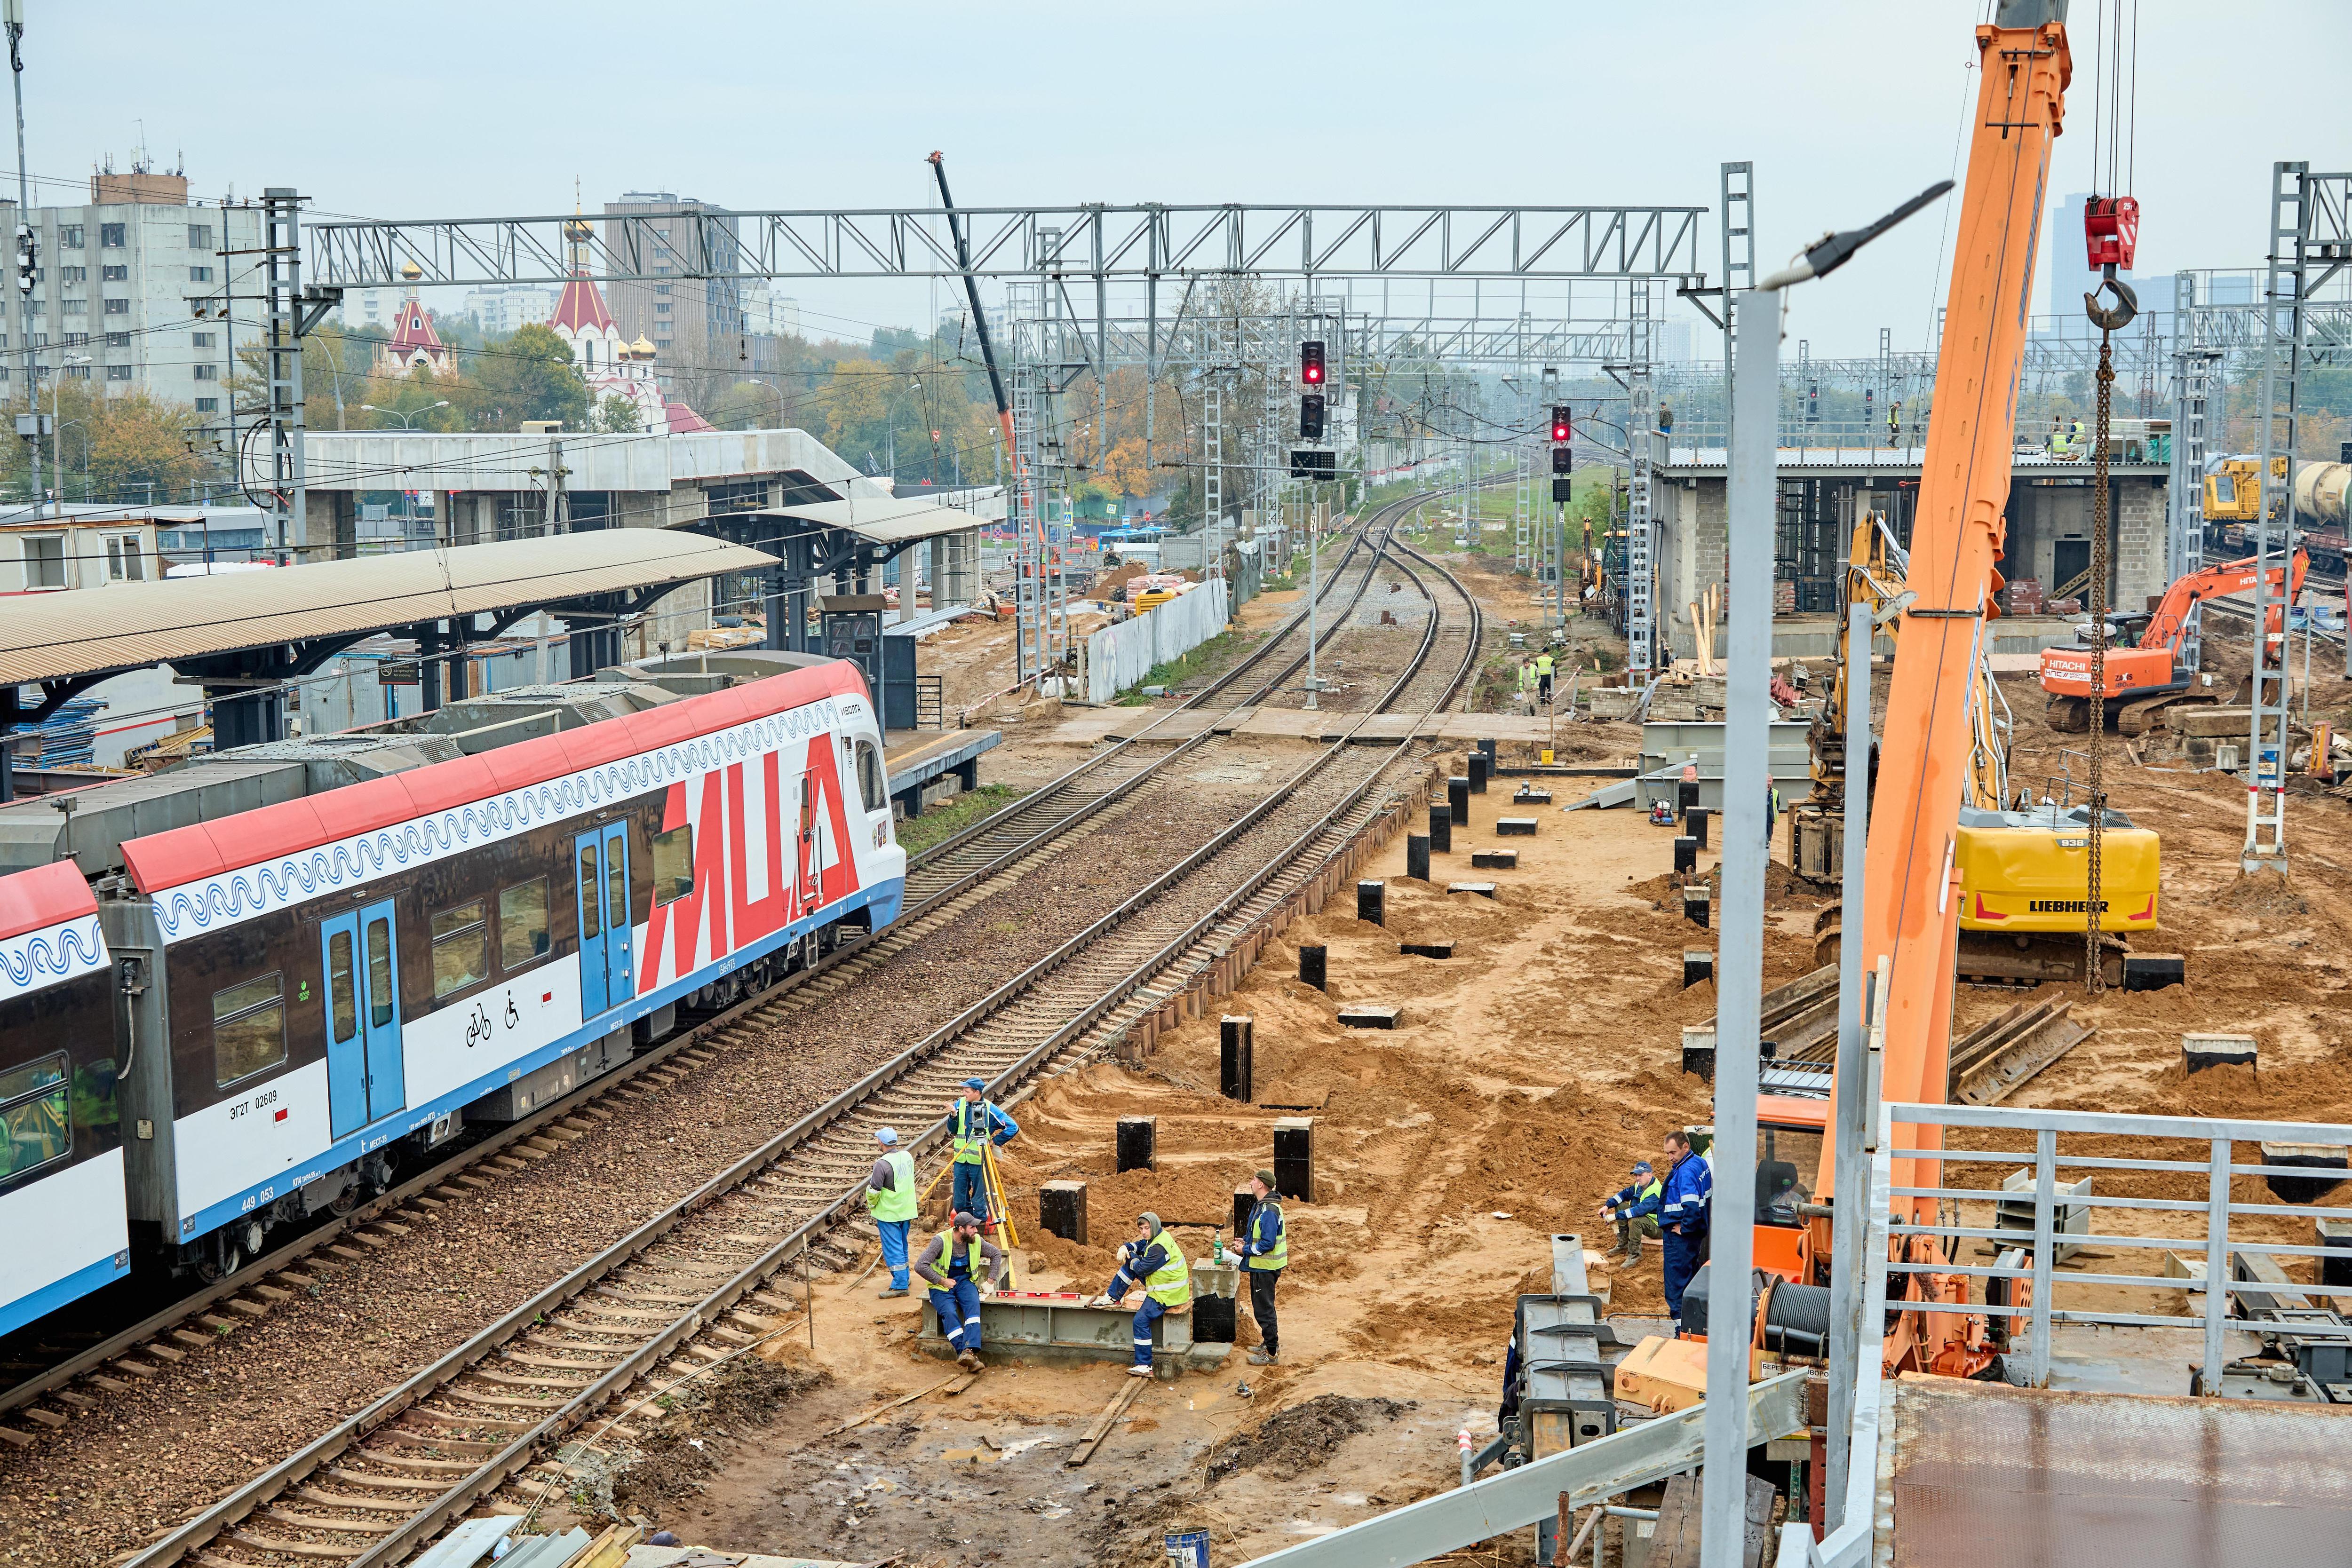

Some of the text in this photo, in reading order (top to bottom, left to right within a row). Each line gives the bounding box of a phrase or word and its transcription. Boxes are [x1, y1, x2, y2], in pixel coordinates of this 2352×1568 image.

[2240, 574, 2270, 585] HITAI
[2050, 659, 2085, 671] HITACHI
[2115, 673, 2133, 681] ZAXIS
[840, 704, 861, 716] ИВОЛГА
[637, 731, 860, 994] МЦД
[2029, 900, 2109, 912] LIEBHER
[230, 1090, 277, 1120] ЭГ2Т 02609
[370, 1134, 387, 1149] МЕСТ-28
[293, 1176, 302, 1188] КП4
[242, 1186, 274, 1212] 449 053
